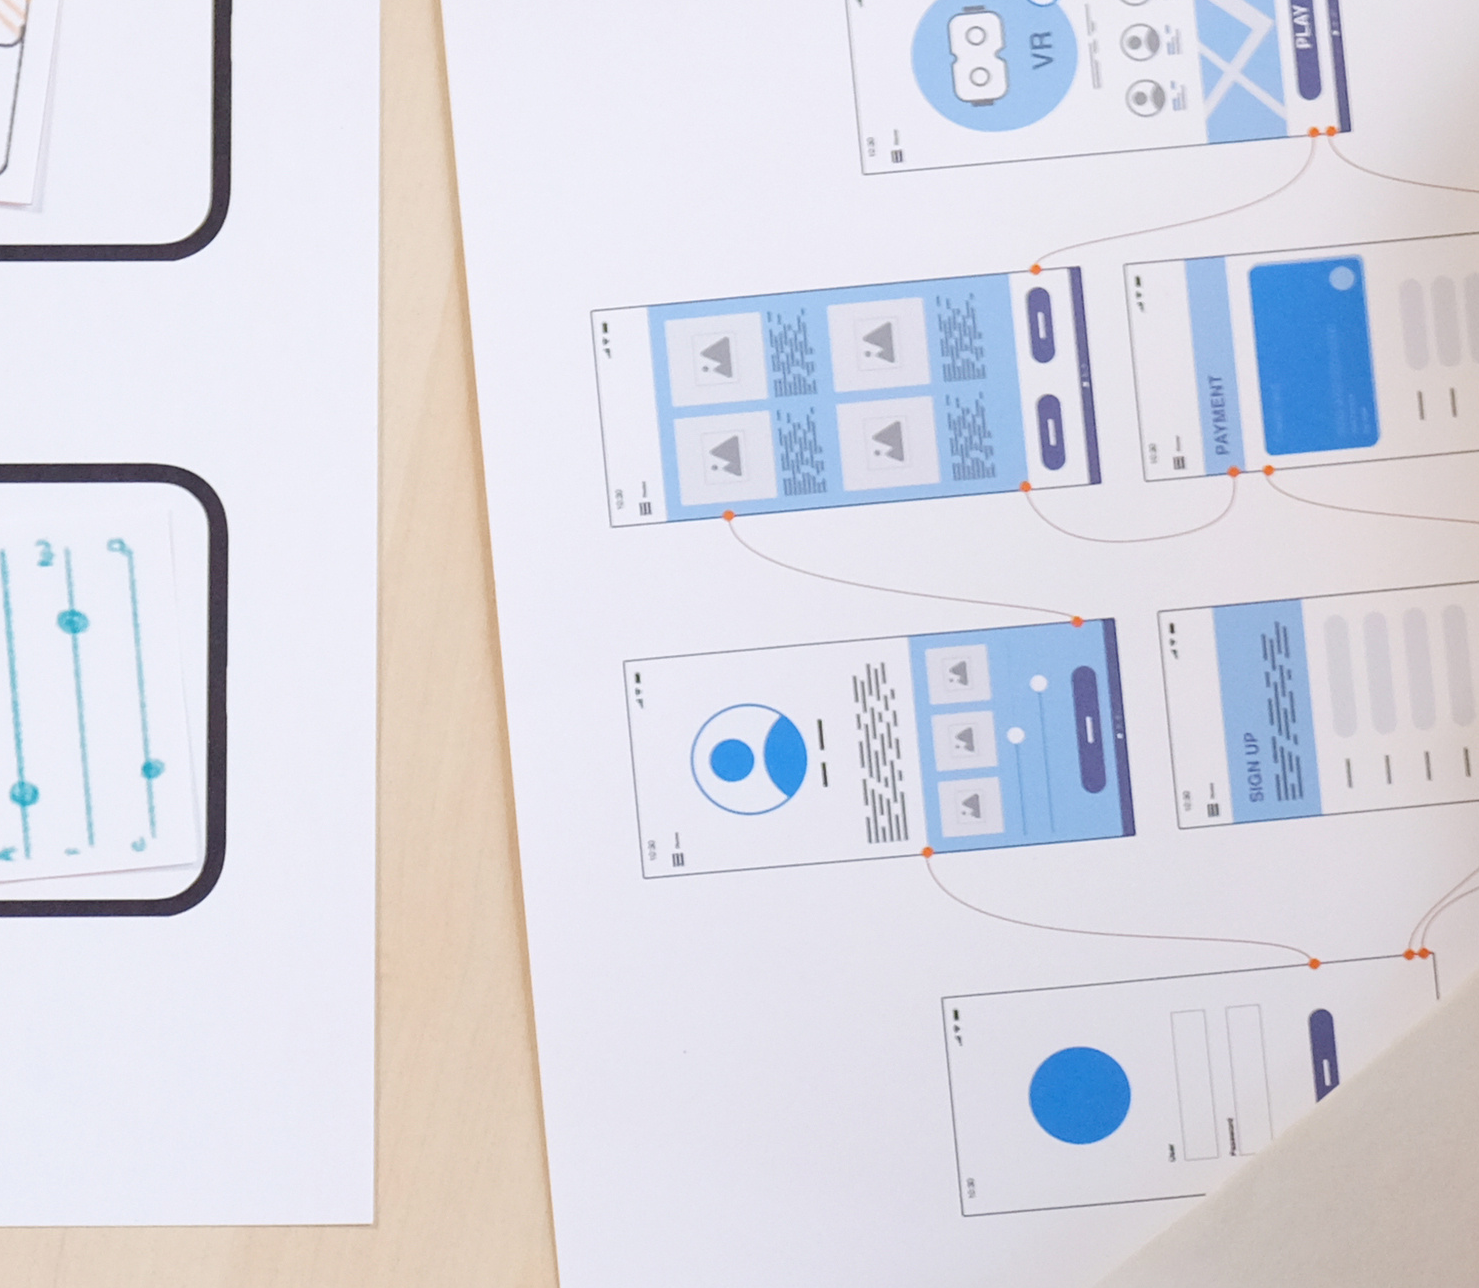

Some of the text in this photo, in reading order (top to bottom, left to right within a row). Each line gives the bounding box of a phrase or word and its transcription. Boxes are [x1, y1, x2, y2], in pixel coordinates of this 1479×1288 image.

[1030, 30, 1056, 71] VR
[1291, 4, 1313, 50] PLAY
[1208, 374, 1228, 456] PAYMENT
[1244, 732, 1263, 803] SIGN UP
